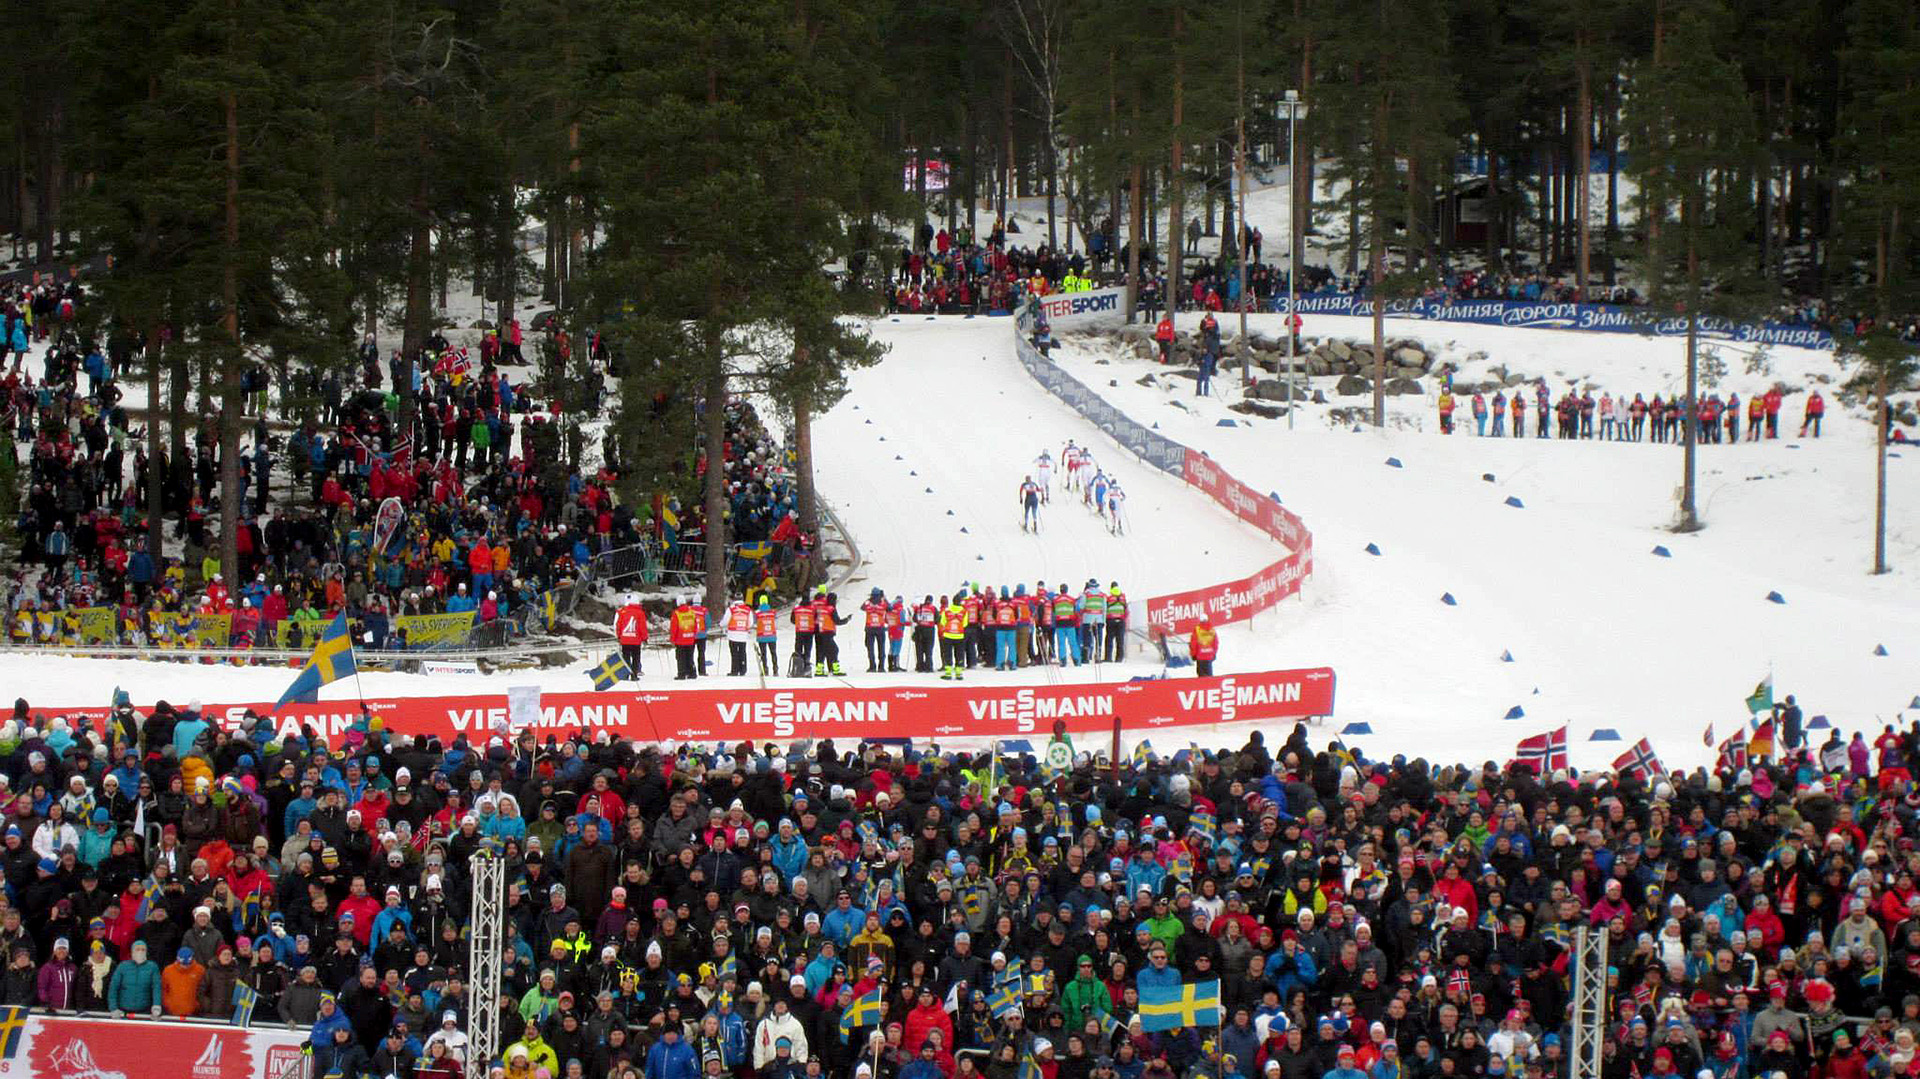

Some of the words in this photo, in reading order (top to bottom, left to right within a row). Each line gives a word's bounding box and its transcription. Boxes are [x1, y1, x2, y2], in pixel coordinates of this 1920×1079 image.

[1040, 294, 1118, 317] TERSPORT
[1427, 304, 1503, 320] ЗИМНЯЯ
[1503, 304, 1576, 324] ДОРОГА
[1736, 324, 1820, 344] ЗИМНЯЯ
[716, 692, 889, 736] VIESSMANN
[968, 688, 1113, 732] VIESSMANN
[1177, 678, 1301, 721] VIESSMANN
[448, 705, 628, 737] VIEMANN
